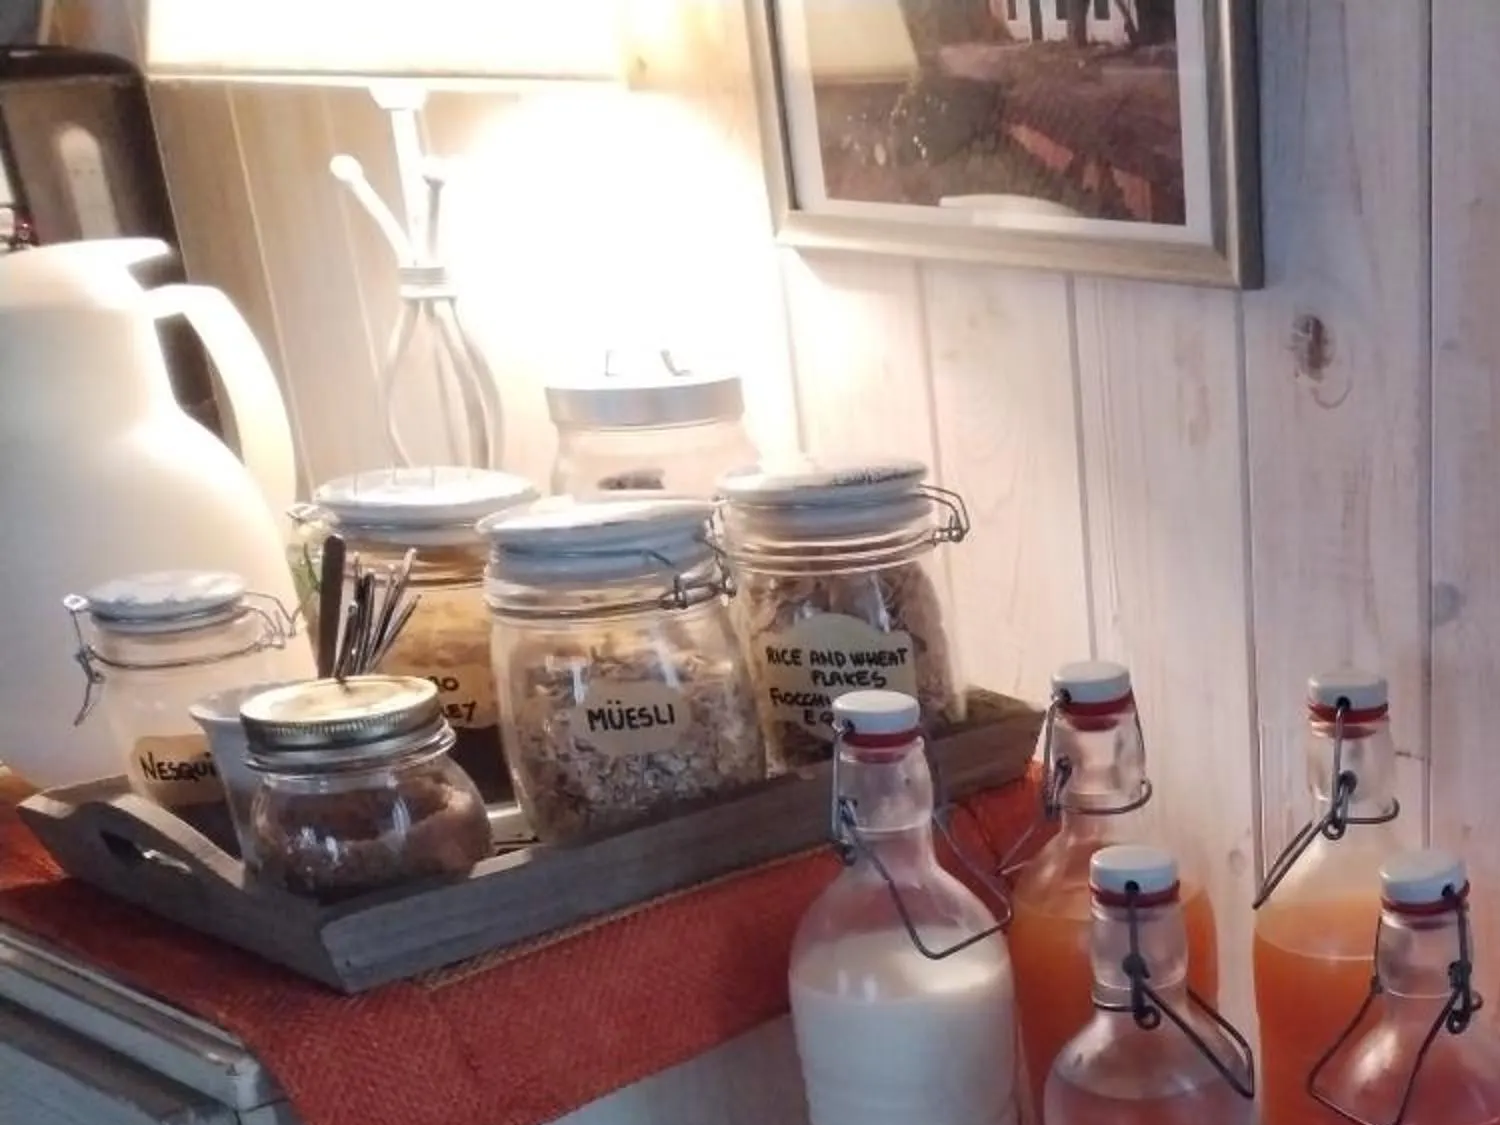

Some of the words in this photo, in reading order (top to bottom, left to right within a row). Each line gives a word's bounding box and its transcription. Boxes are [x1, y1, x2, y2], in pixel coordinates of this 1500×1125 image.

[766, 647, 802, 667] RICE
[809, 648, 846, 668] AND
[850, 647, 908, 667] WHEAT
[811, 669, 887, 688] FLAKES
[587, 699, 675, 732] MÜESLI
[139, 751, 217, 782] NESQUI
